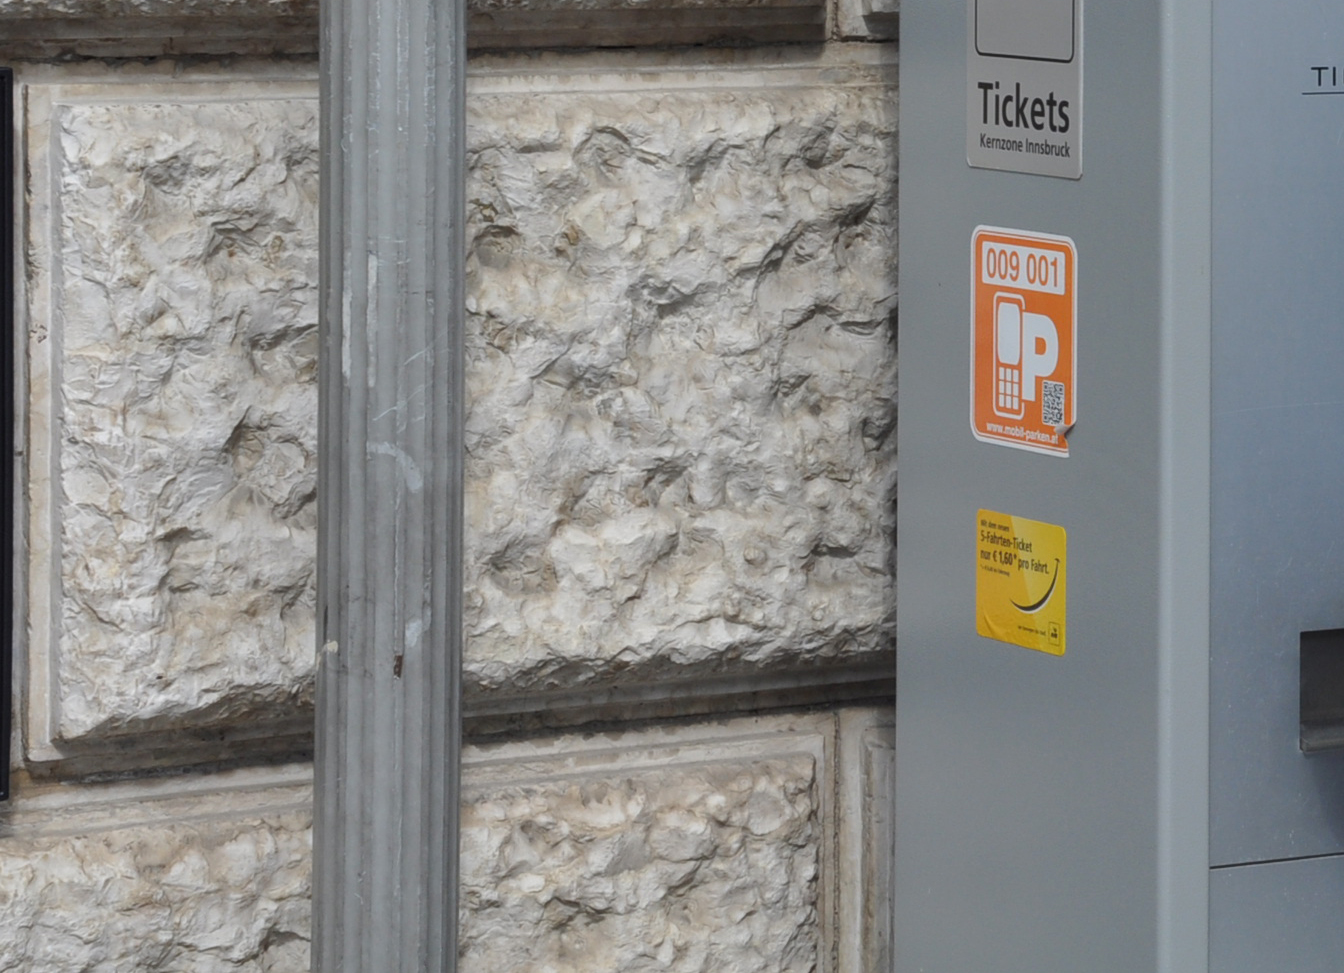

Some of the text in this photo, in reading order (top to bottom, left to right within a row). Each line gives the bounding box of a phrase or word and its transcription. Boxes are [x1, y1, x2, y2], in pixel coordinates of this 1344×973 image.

[978, 82, 1070, 133] Tickets
[979, 132, 1071, 158] Kernzone Innsbruck
[986, 247, 1059, 288] 009 001
[1022, 311, 1059, 402] P
[986, 422, 1059, 445] www.mobil-parken.at
[1018, 558, 1029, 571] pro
